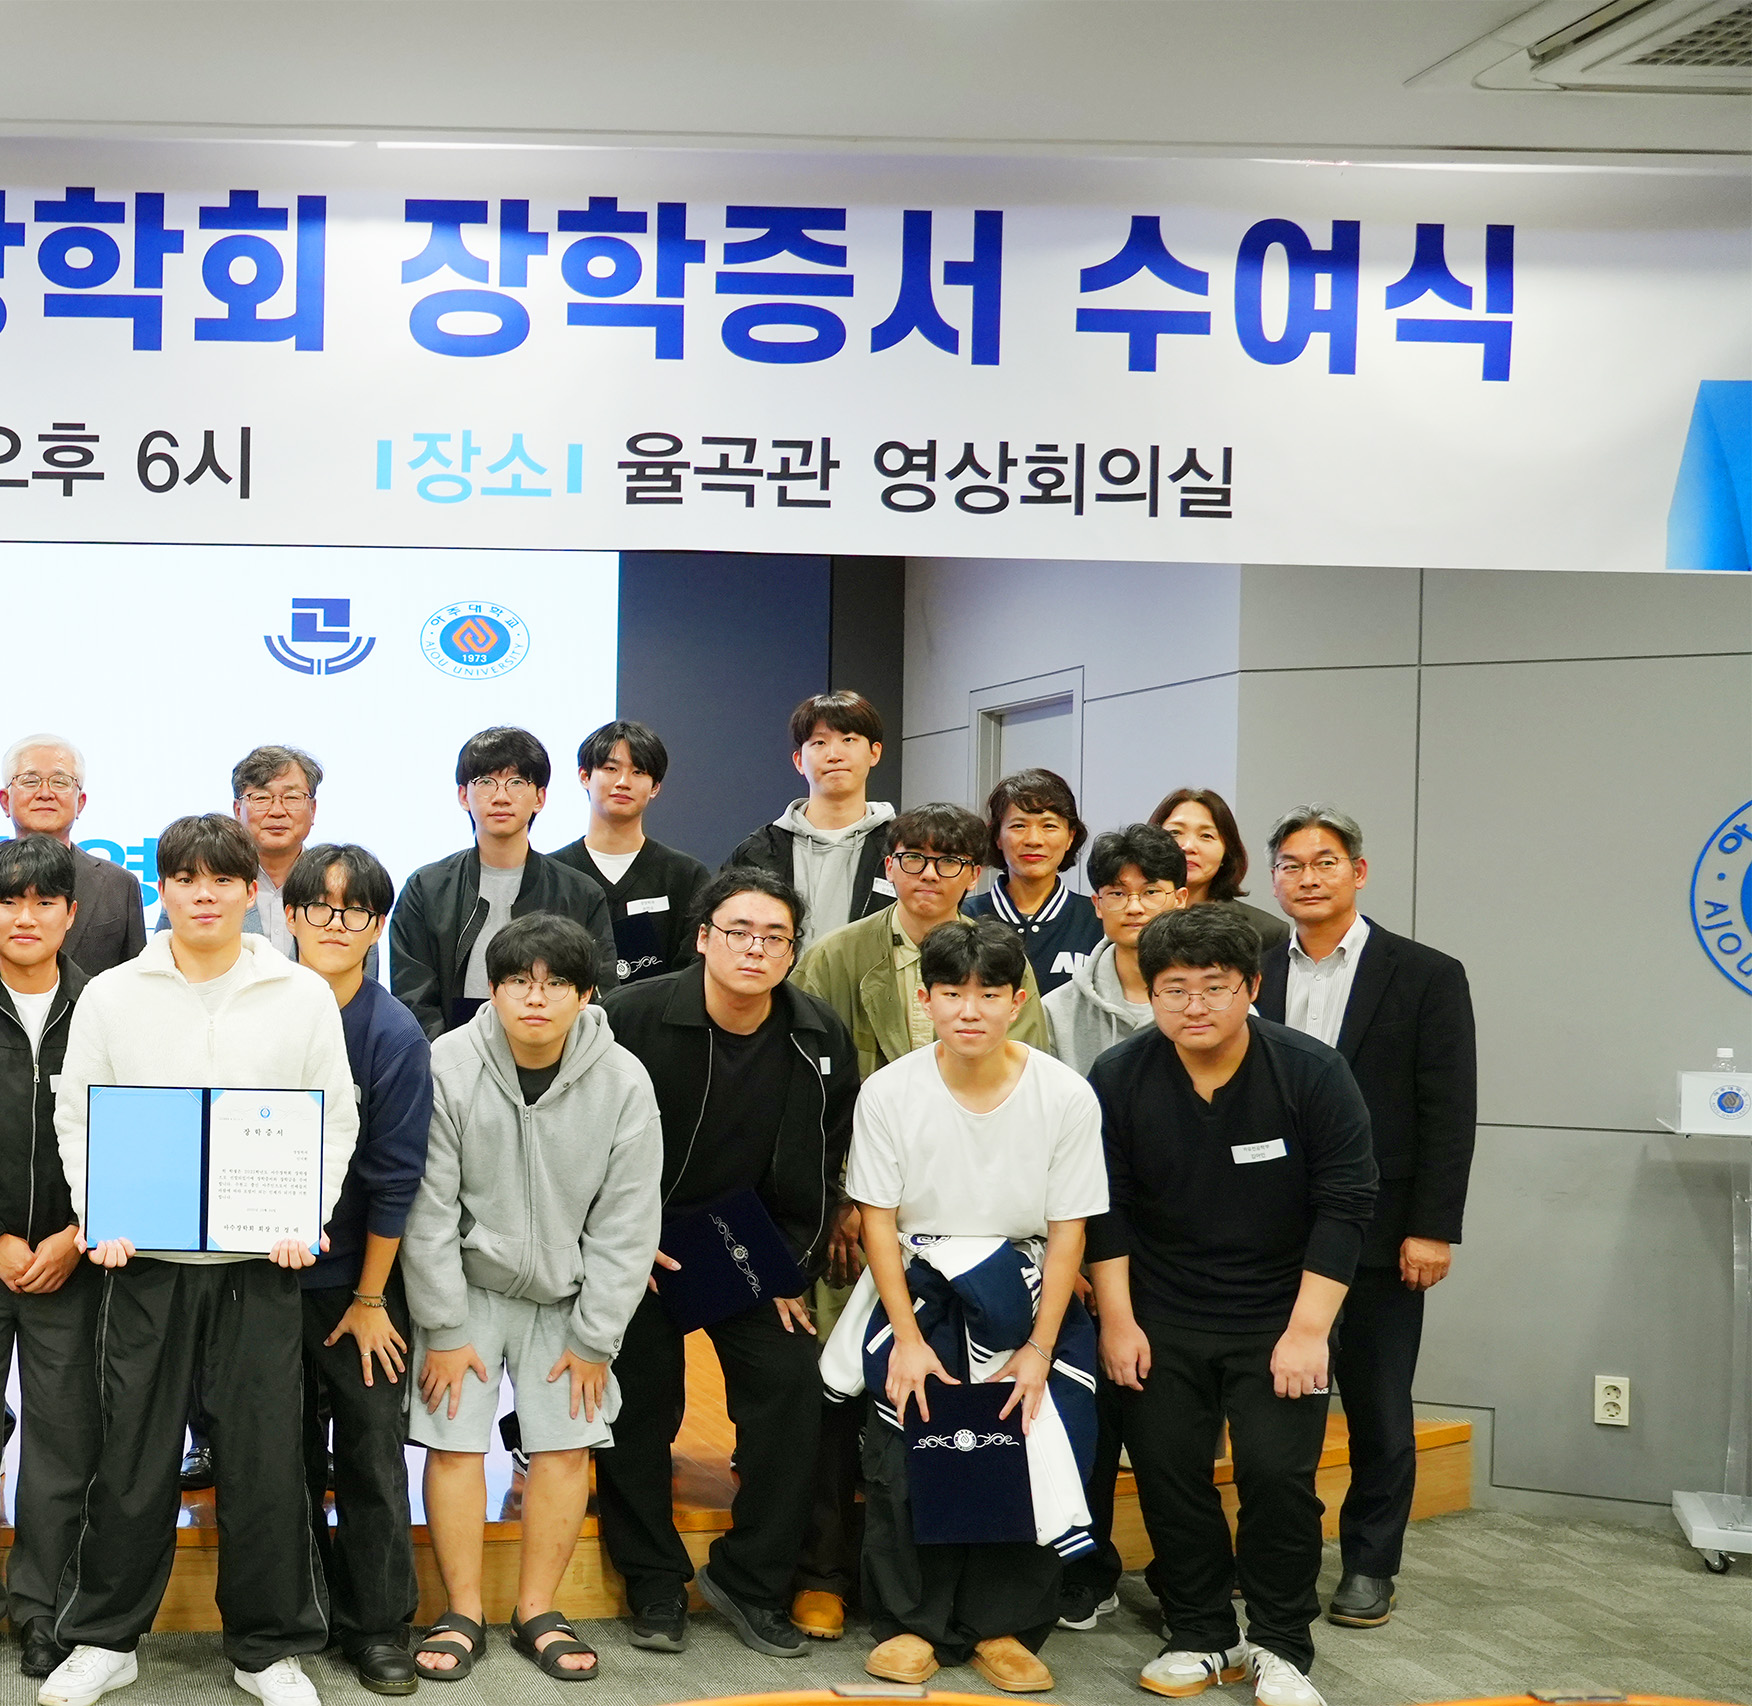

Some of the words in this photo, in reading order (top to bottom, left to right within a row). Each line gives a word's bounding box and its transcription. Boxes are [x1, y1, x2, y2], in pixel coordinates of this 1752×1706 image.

[401, 197, 1004, 366] 장학증서
[1076, 215, 1515, 382] 수여식
[137, 426, 252, 500] 6시
[408, 430, 553, 505] 장소
[617, 432, 842, 510] 율곡관
[873, 439, 1235, 520] 영상회의실
[430, 603, 520, 629] 아주대학교
[452, 641, 525, 677] UNIVERSITY
[462, 653, 488, 663] 1973
